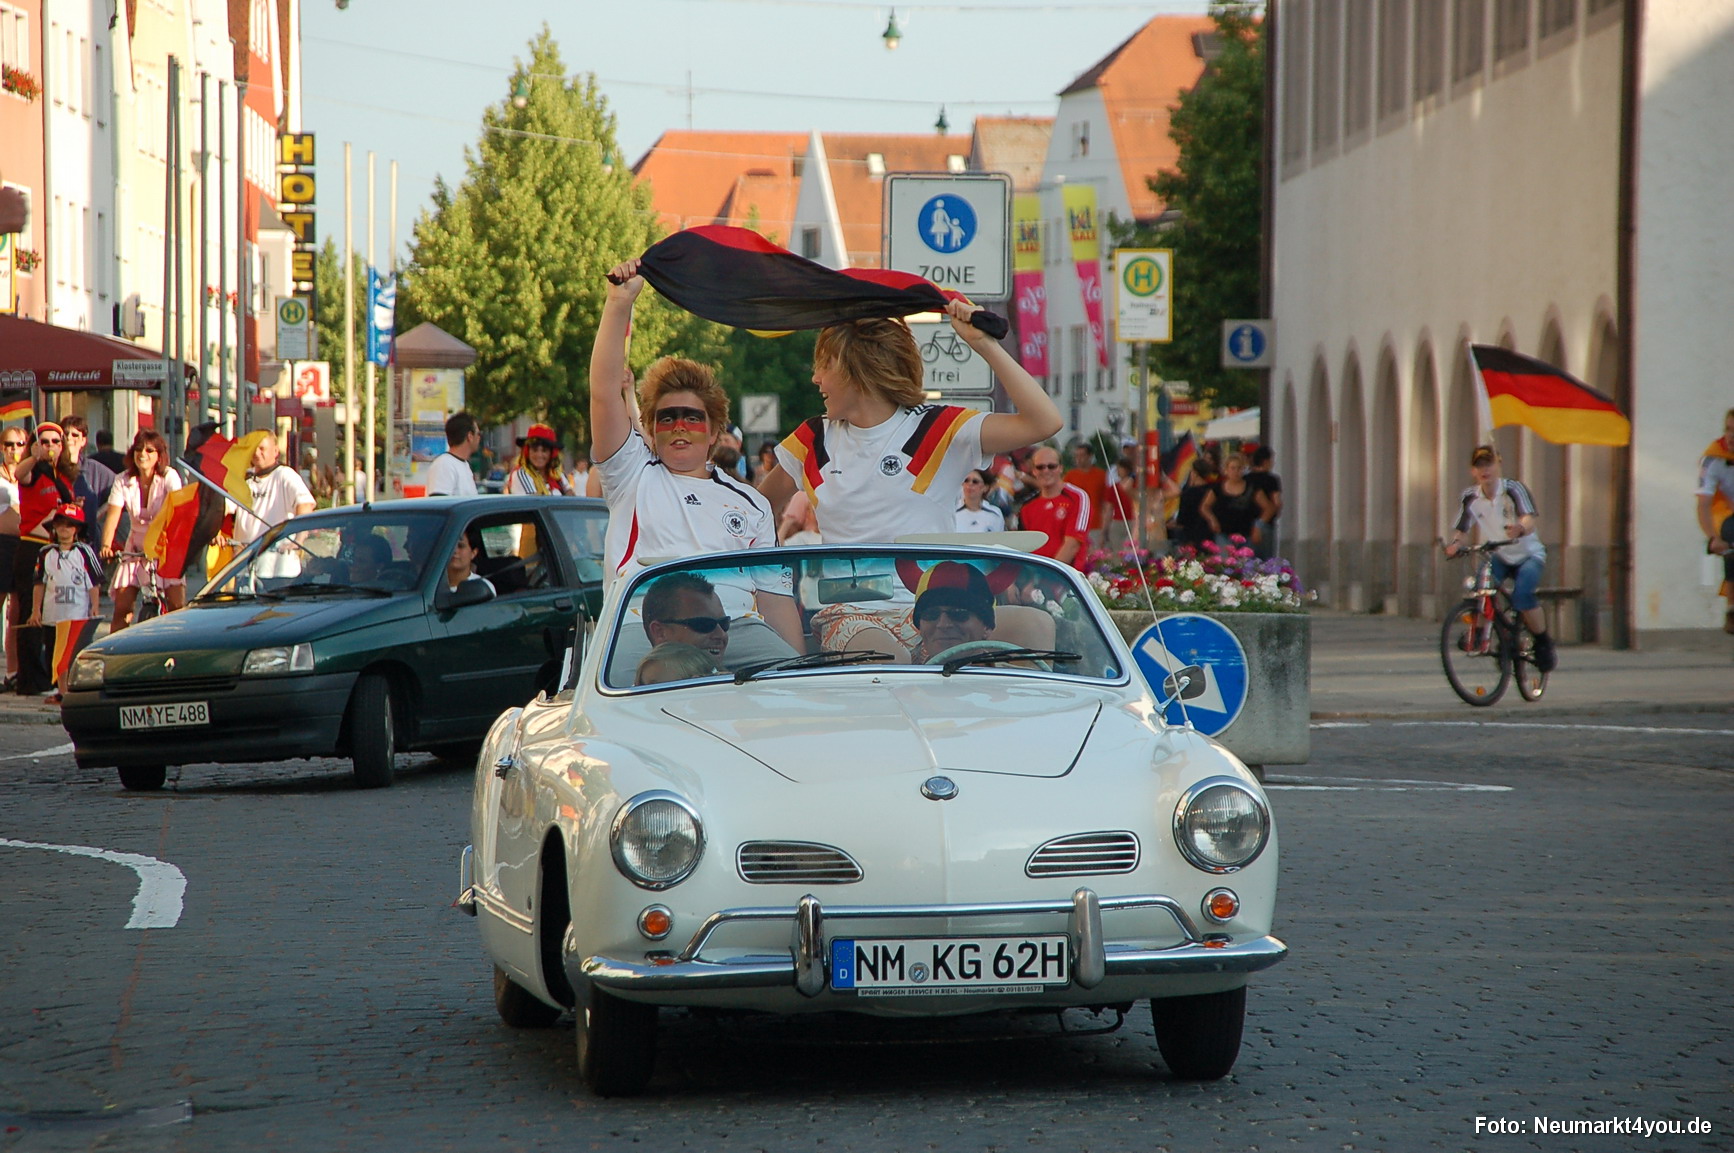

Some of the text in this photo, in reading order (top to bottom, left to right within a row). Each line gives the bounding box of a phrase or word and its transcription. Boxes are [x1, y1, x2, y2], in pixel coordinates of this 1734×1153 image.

[282, 135, 314, 318] HOTE
[919, 265, 976, 284] ZONE
[116, 360, 163, 371] Klostergasse
[47, 370, 101, 381] Stadtcafé
[931, 368, 960, 382] frei
[55, 585, 76, 604] 20
[121, 704, 207, 727] NM YE 488
[855, 941, 1065, 981] NM KG 62H
[839, 968, 848, 980] D
[907, 987, 933, 995] SERVICE
